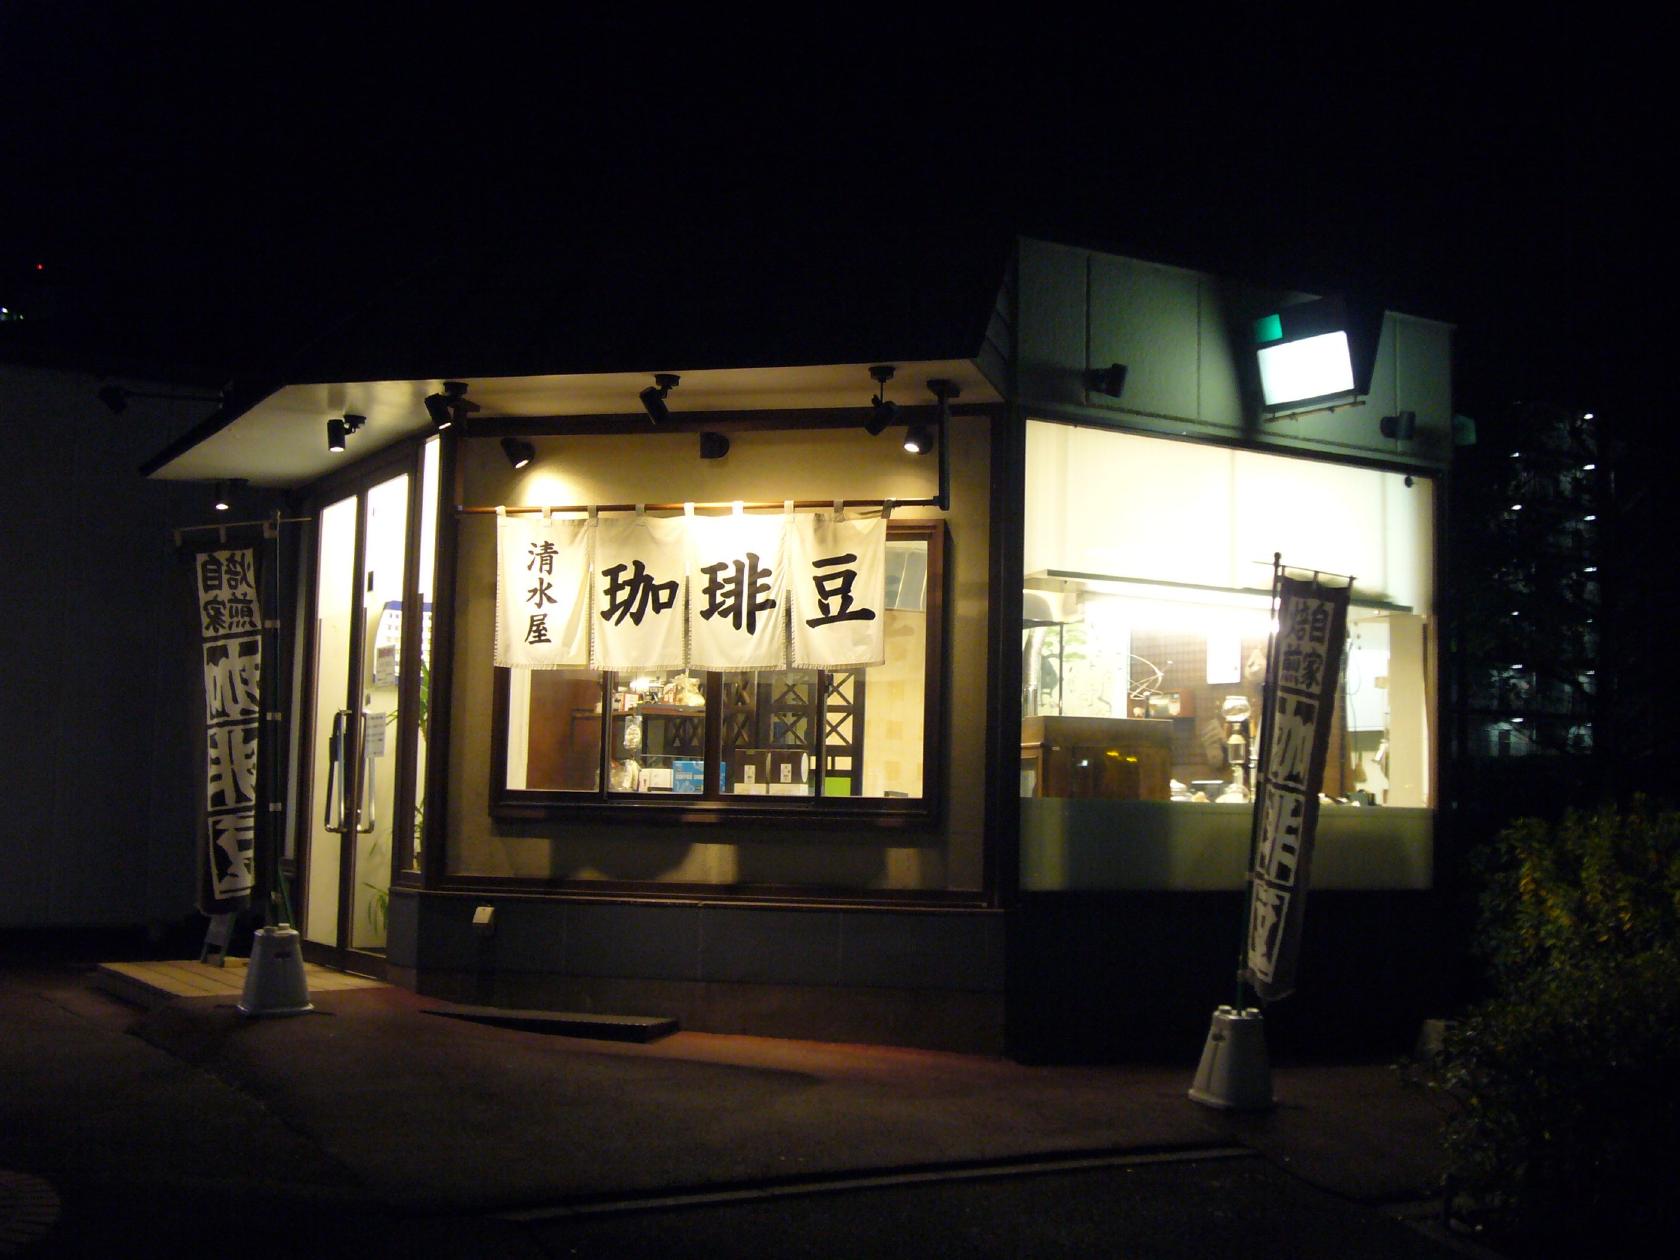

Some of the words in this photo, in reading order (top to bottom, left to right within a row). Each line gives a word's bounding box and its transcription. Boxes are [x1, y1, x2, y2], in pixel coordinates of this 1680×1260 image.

[524, 541, 559, 645] 清水屋
[600, 552, 876, 636] 珈琲豆
